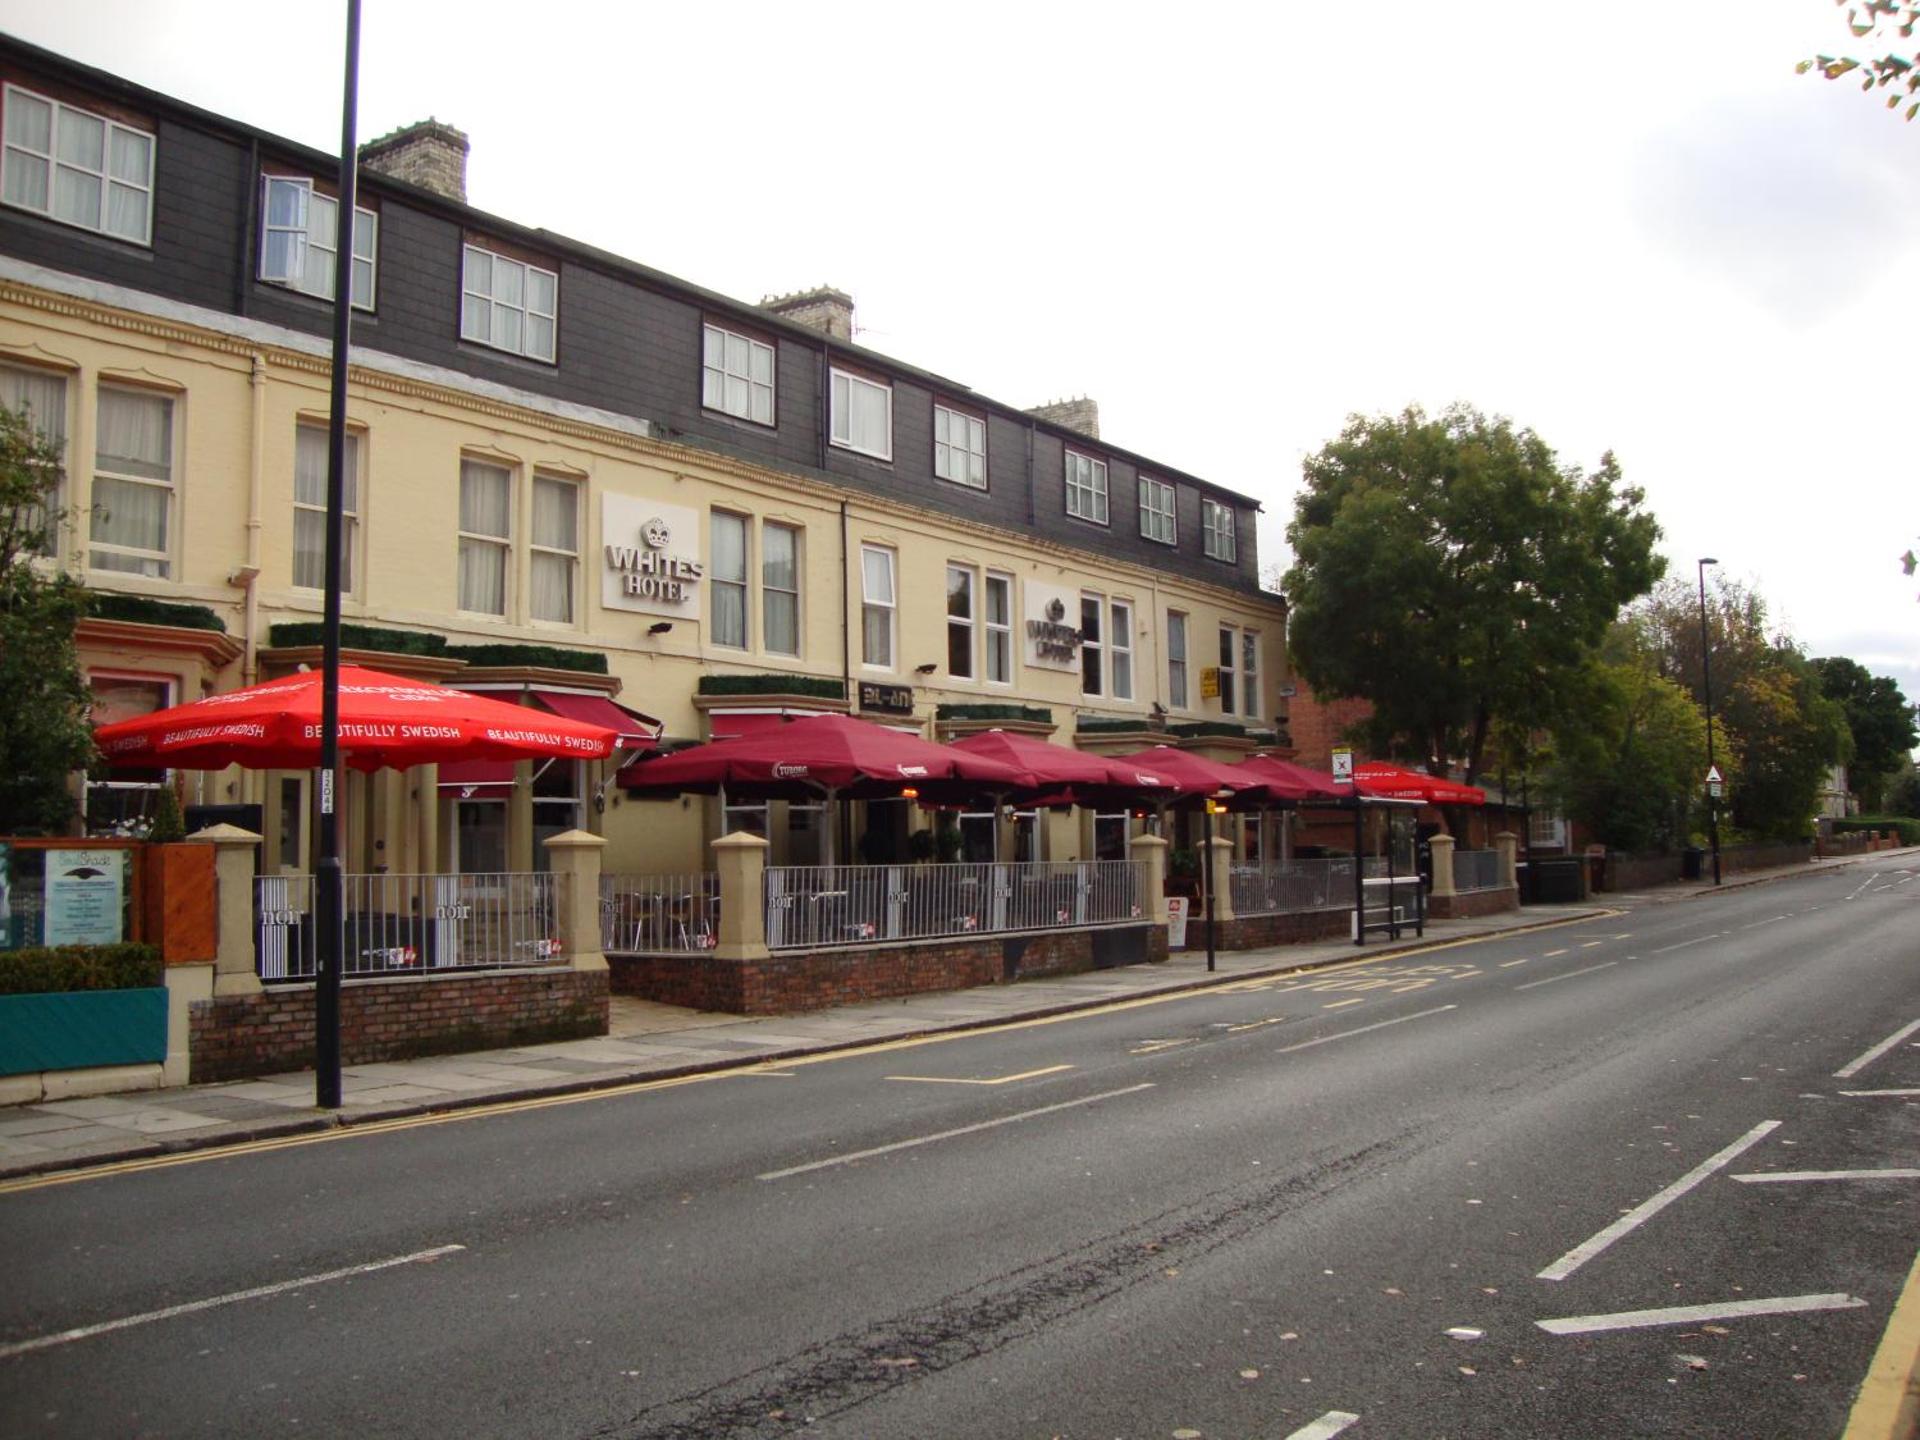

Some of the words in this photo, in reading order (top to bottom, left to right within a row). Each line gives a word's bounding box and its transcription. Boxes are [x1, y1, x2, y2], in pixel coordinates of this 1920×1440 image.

[604, 544, 704, 583] WHITES
[623, 574, 690, 605] HOTEL
[163, 726, 221, 745] BEAUTIFULLY
[221, 722, 265, 738] SWEDISH
[305, 724, 396, 738] BEUTIFULLY
[401, 725, 461, 738] SWEDISH
[487, 728, 562, 745] BEAUTIFULLY
[262, 903, 305, 925] noir
[436, 900, 472, 920] noir
